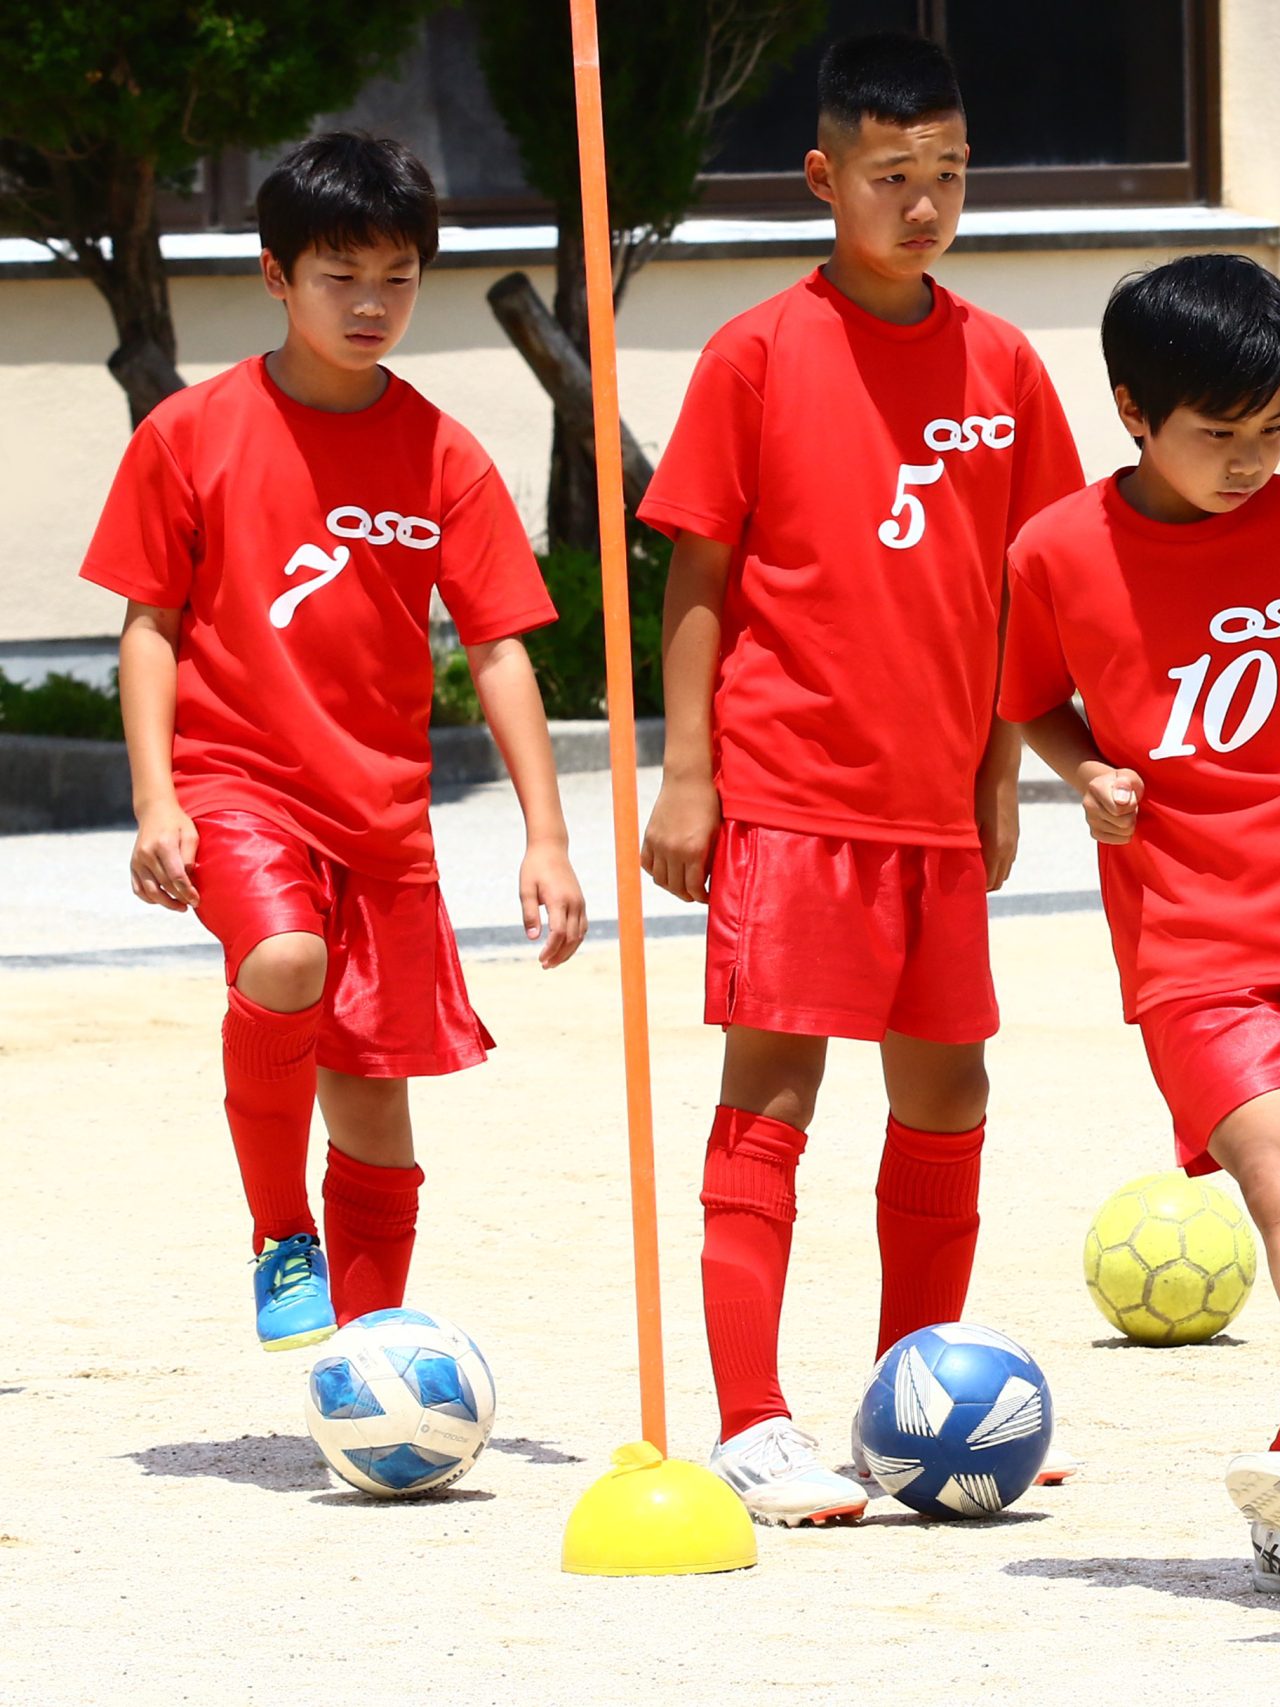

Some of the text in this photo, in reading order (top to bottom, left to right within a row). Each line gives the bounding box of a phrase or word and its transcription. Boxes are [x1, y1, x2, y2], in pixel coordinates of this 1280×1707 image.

[877, 457, 945, 550] 5
[269, 543, 350, 629] 7
[1148, 649, 1279, 761] 10
